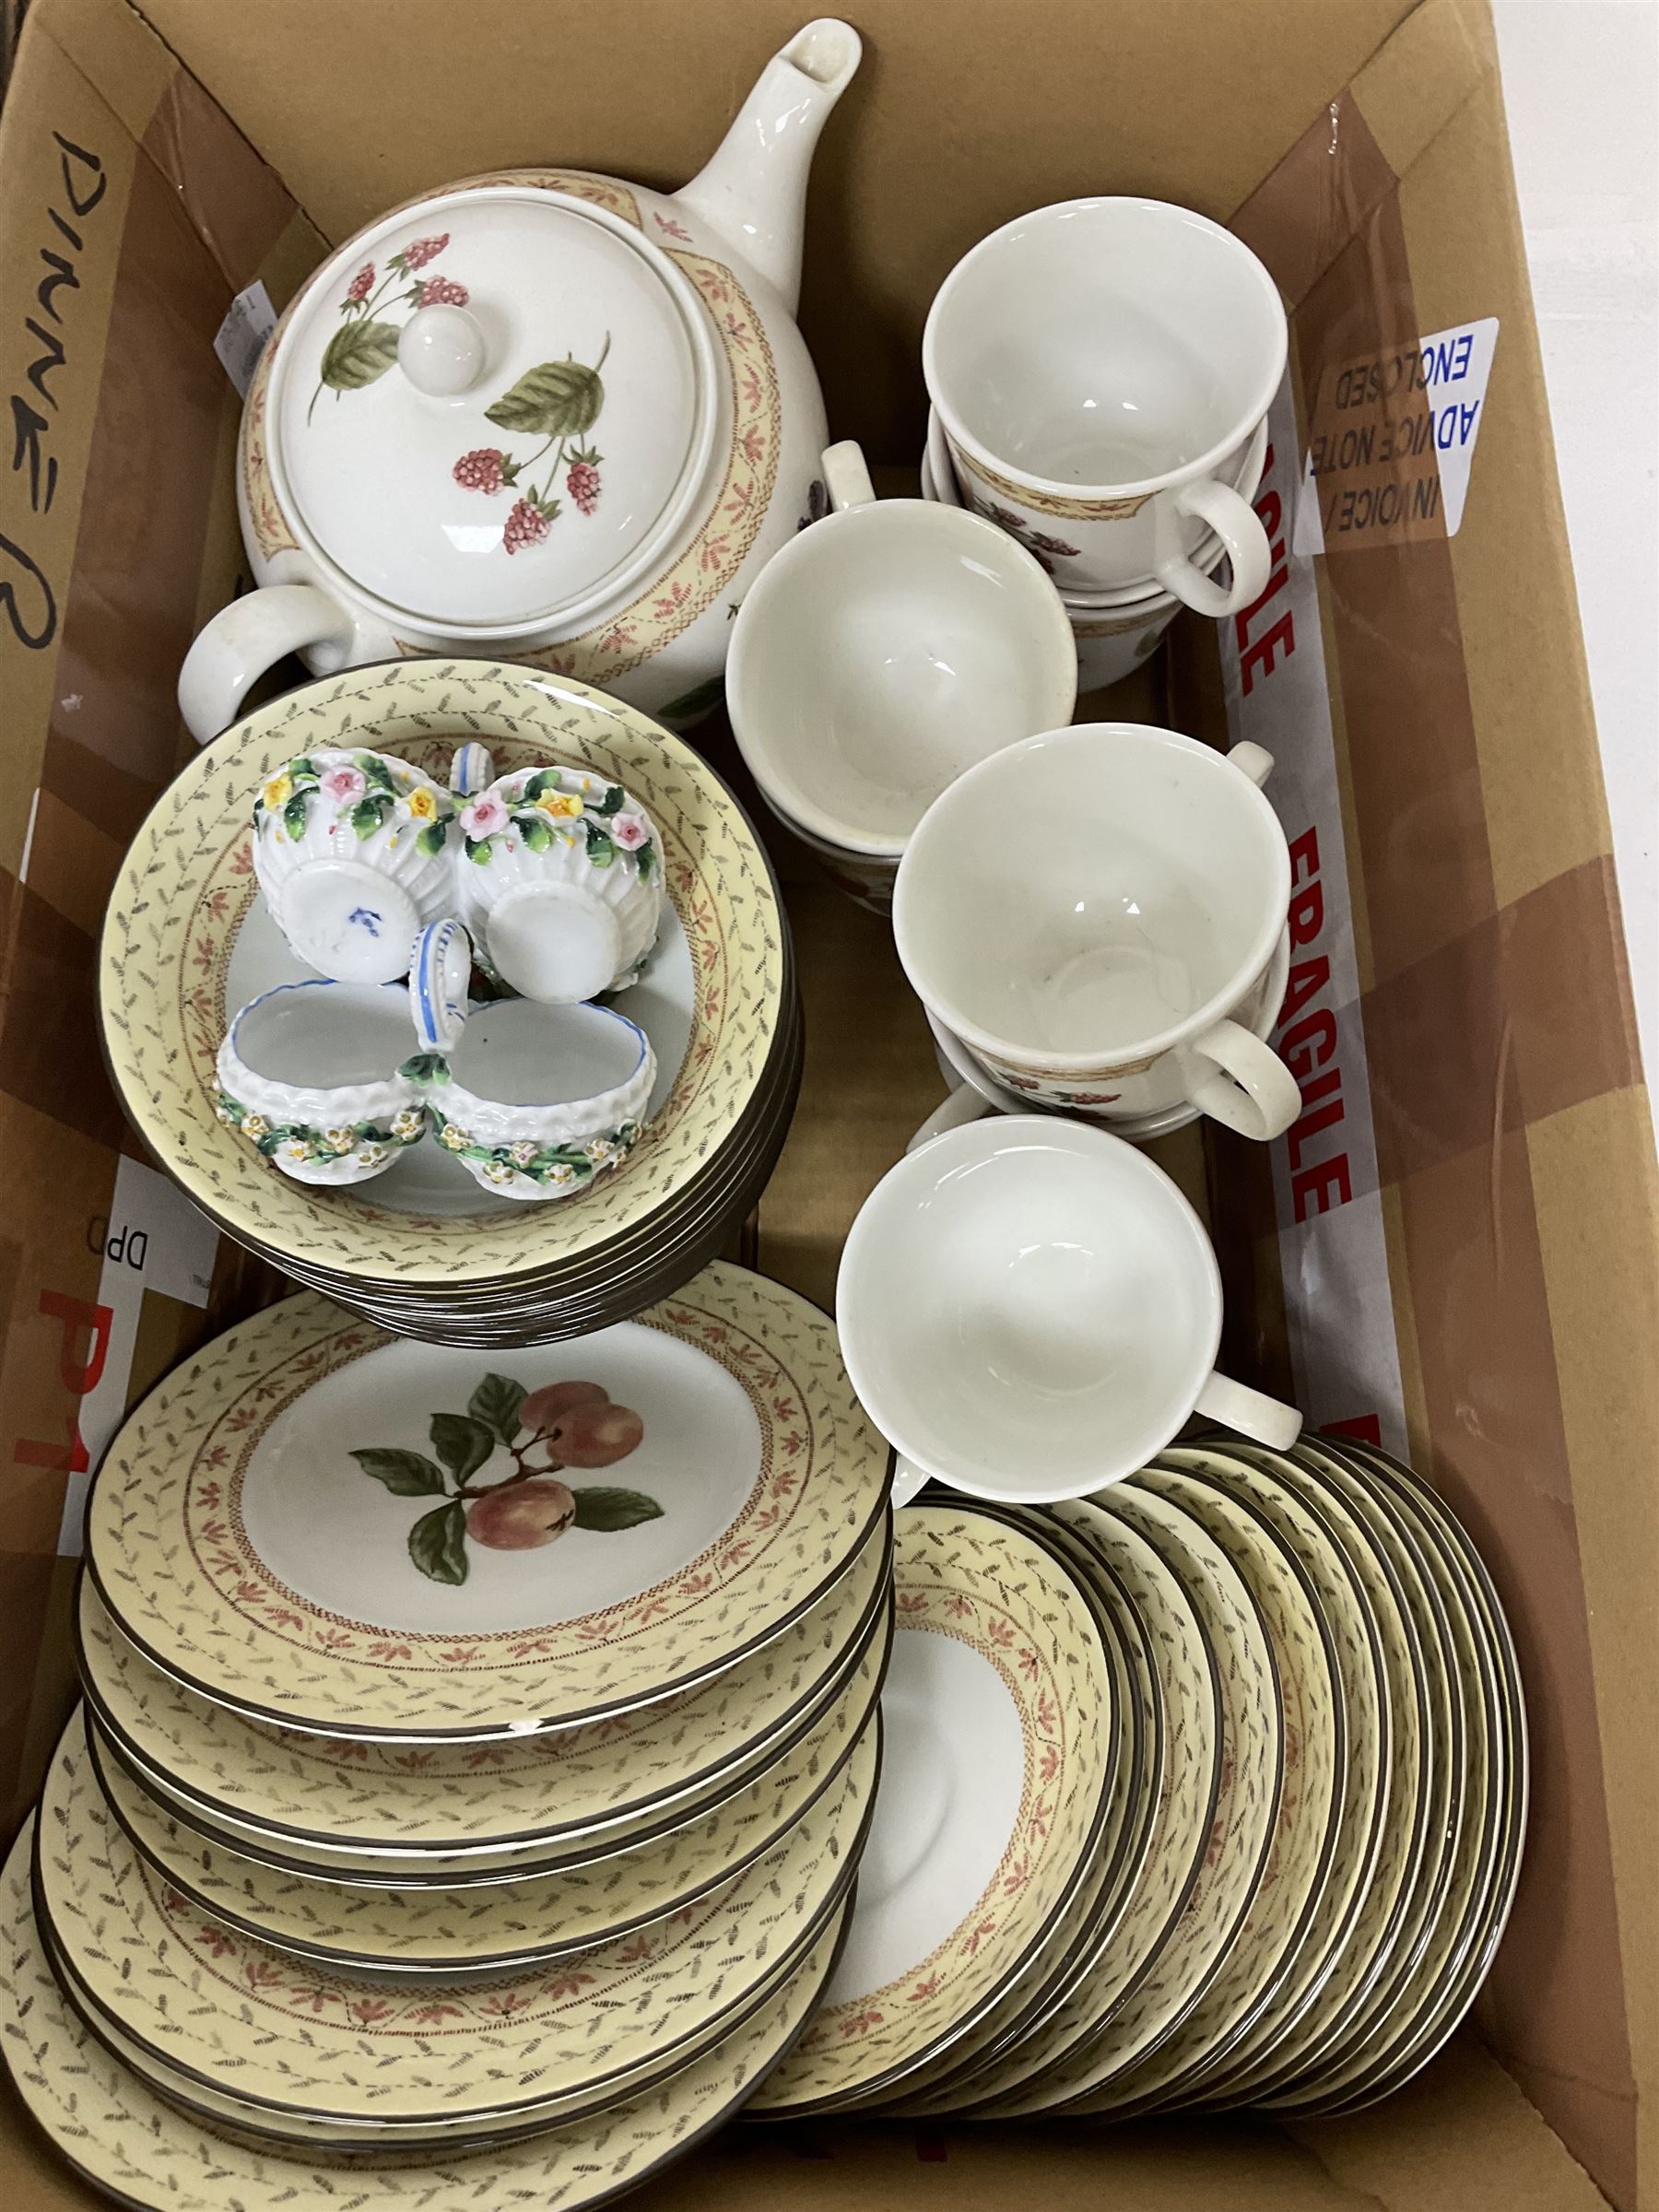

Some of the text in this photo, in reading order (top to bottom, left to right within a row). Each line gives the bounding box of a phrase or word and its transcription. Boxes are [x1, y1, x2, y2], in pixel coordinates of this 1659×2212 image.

[1310, 400, 1479, 476] ADVICE NOTE
[88, 1216, 147, 1270] DPD
